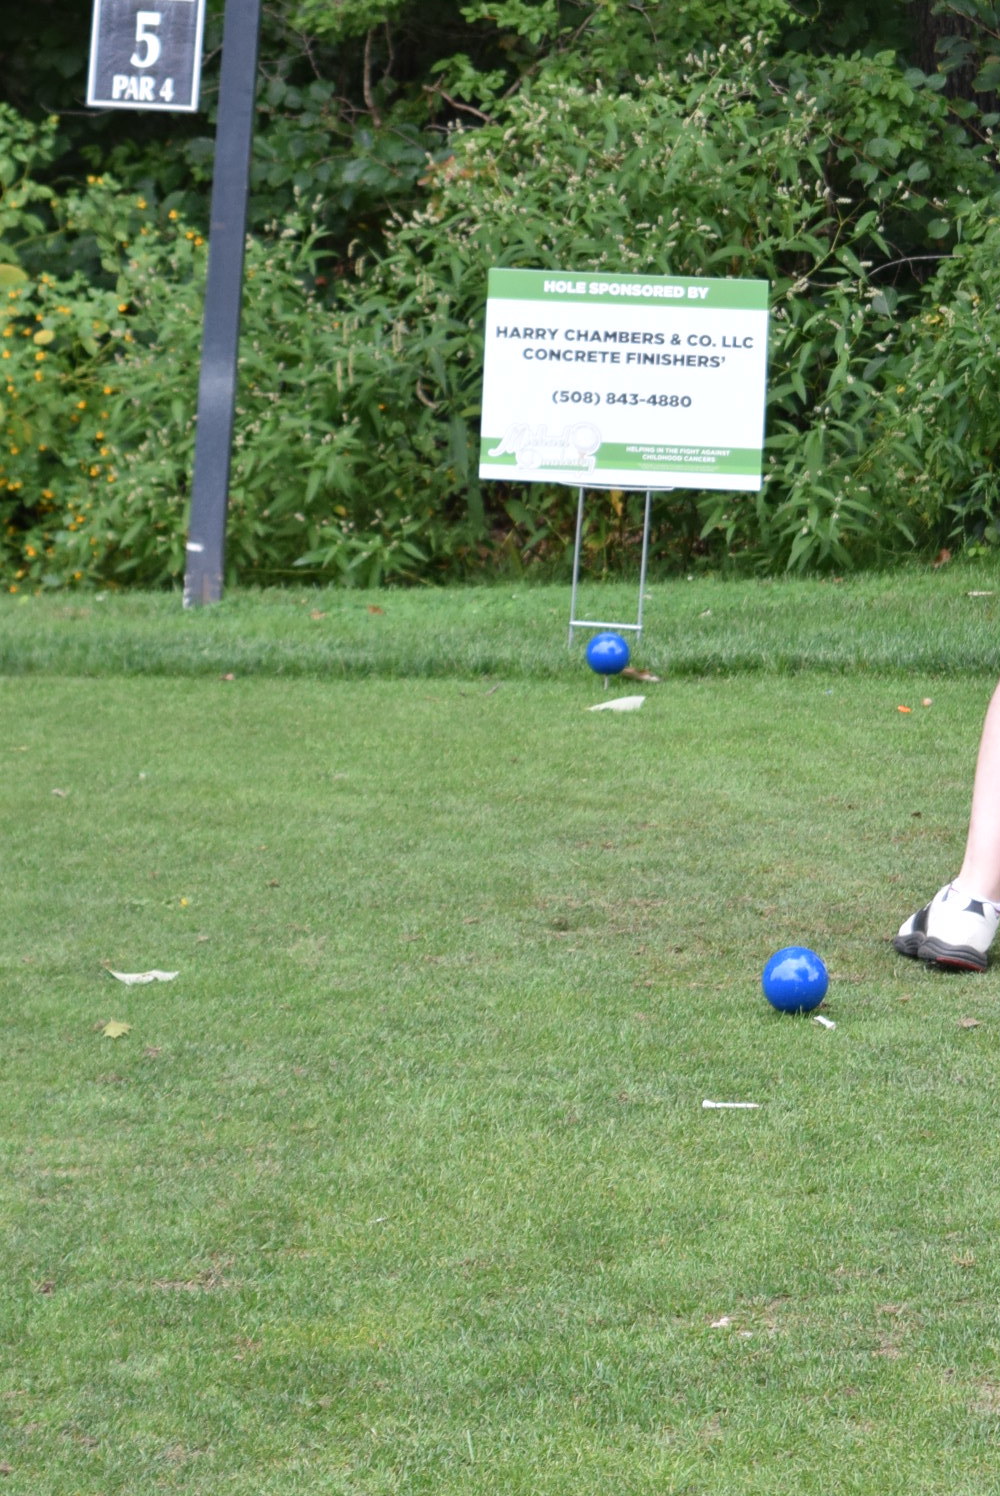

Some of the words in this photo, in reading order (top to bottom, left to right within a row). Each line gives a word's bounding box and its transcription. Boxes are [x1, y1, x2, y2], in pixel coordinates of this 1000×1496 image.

[130, 11, 161, 68] 5
[112, 74, 155, 101] PAR
[159, 77, 174, 102] 4
[543, 280, 587, 295] HOLE
[588, 281, 686, 299] SPONSORED
[687, 286, 710, 300] BY
[496, 326, 559, 341] HARRY
[564, 328, 665, 345] CHAMBERS
[670, 333, 681, 346] &
[686, 334, 717, 348] CO.
[722, 336, 754, 349] LLC
[522, 348, 621, 364] CONCRETE
[552, 390, 601, 406] (508)
[605, 392, 693, 408] 843-4880
[683, 455, 716, 463] CANCERS
